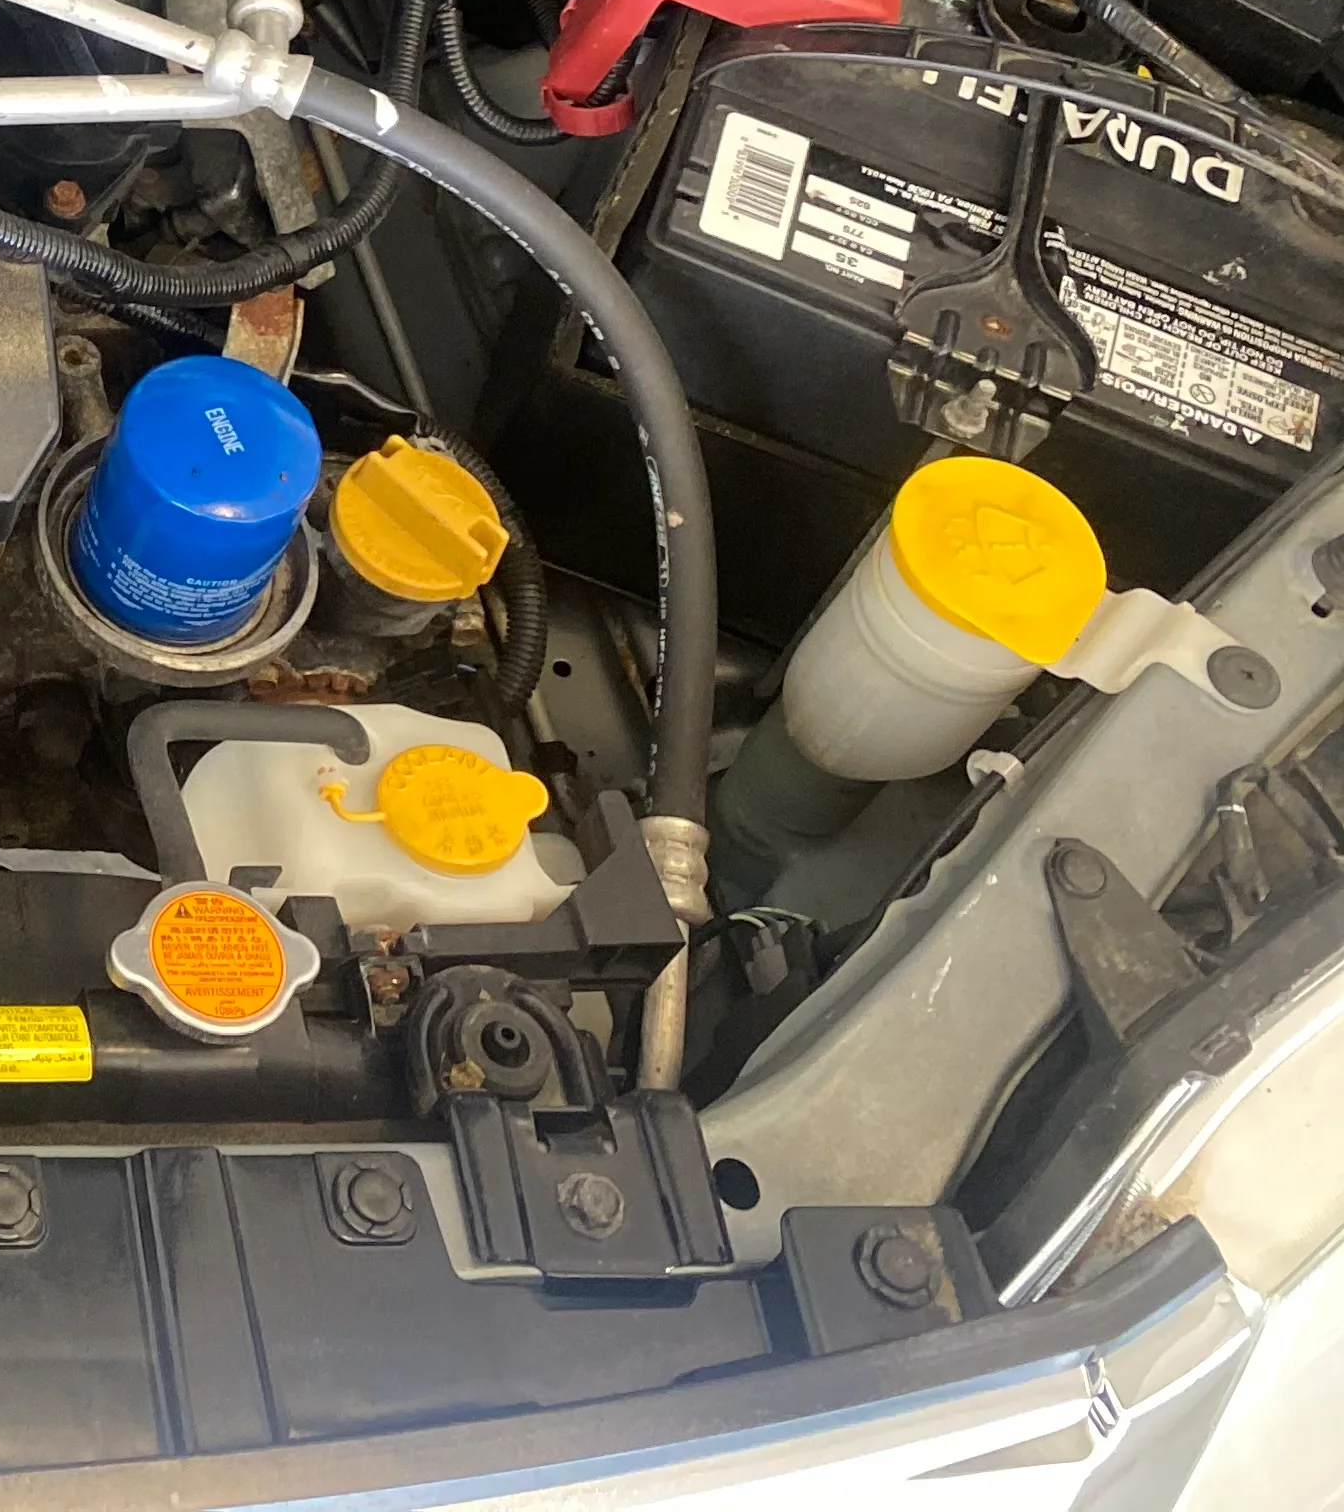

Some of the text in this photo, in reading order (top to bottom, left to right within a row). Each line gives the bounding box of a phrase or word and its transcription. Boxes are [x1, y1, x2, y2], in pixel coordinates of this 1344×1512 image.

[937, 192, 953, 204] PA
[953, 197, 993, 219] Station,
[841, 224, 865, 239] 775
[833, 251, 859, 268] 35
[1134, 302, 1169, 322] OPEN
[1143, 314, 1161, 326] OF
[1161, 321, 1203, 343] REACH
[1169, 316, 1197, 333] NOT
[1197, 327, 1216, 340] DO
[1203, 338, 1222, 351] OF
[1237, 343, 1266, 361] NOT
[1222, 346, 1248, 362] OUT
[1265, 355, 1284, 368] DO
[1249, 357, 1282, 375] KEEP
[1096, 369, 1239, 436] DANGER/POIS
[1235, 385, 1286, 412] EXPLOSIVE
[204, 408, 245, 456] ENGINE
[193, 906, 244, 914] WARNING
[185, 988, 264, 996] AVERTISSEMENT
